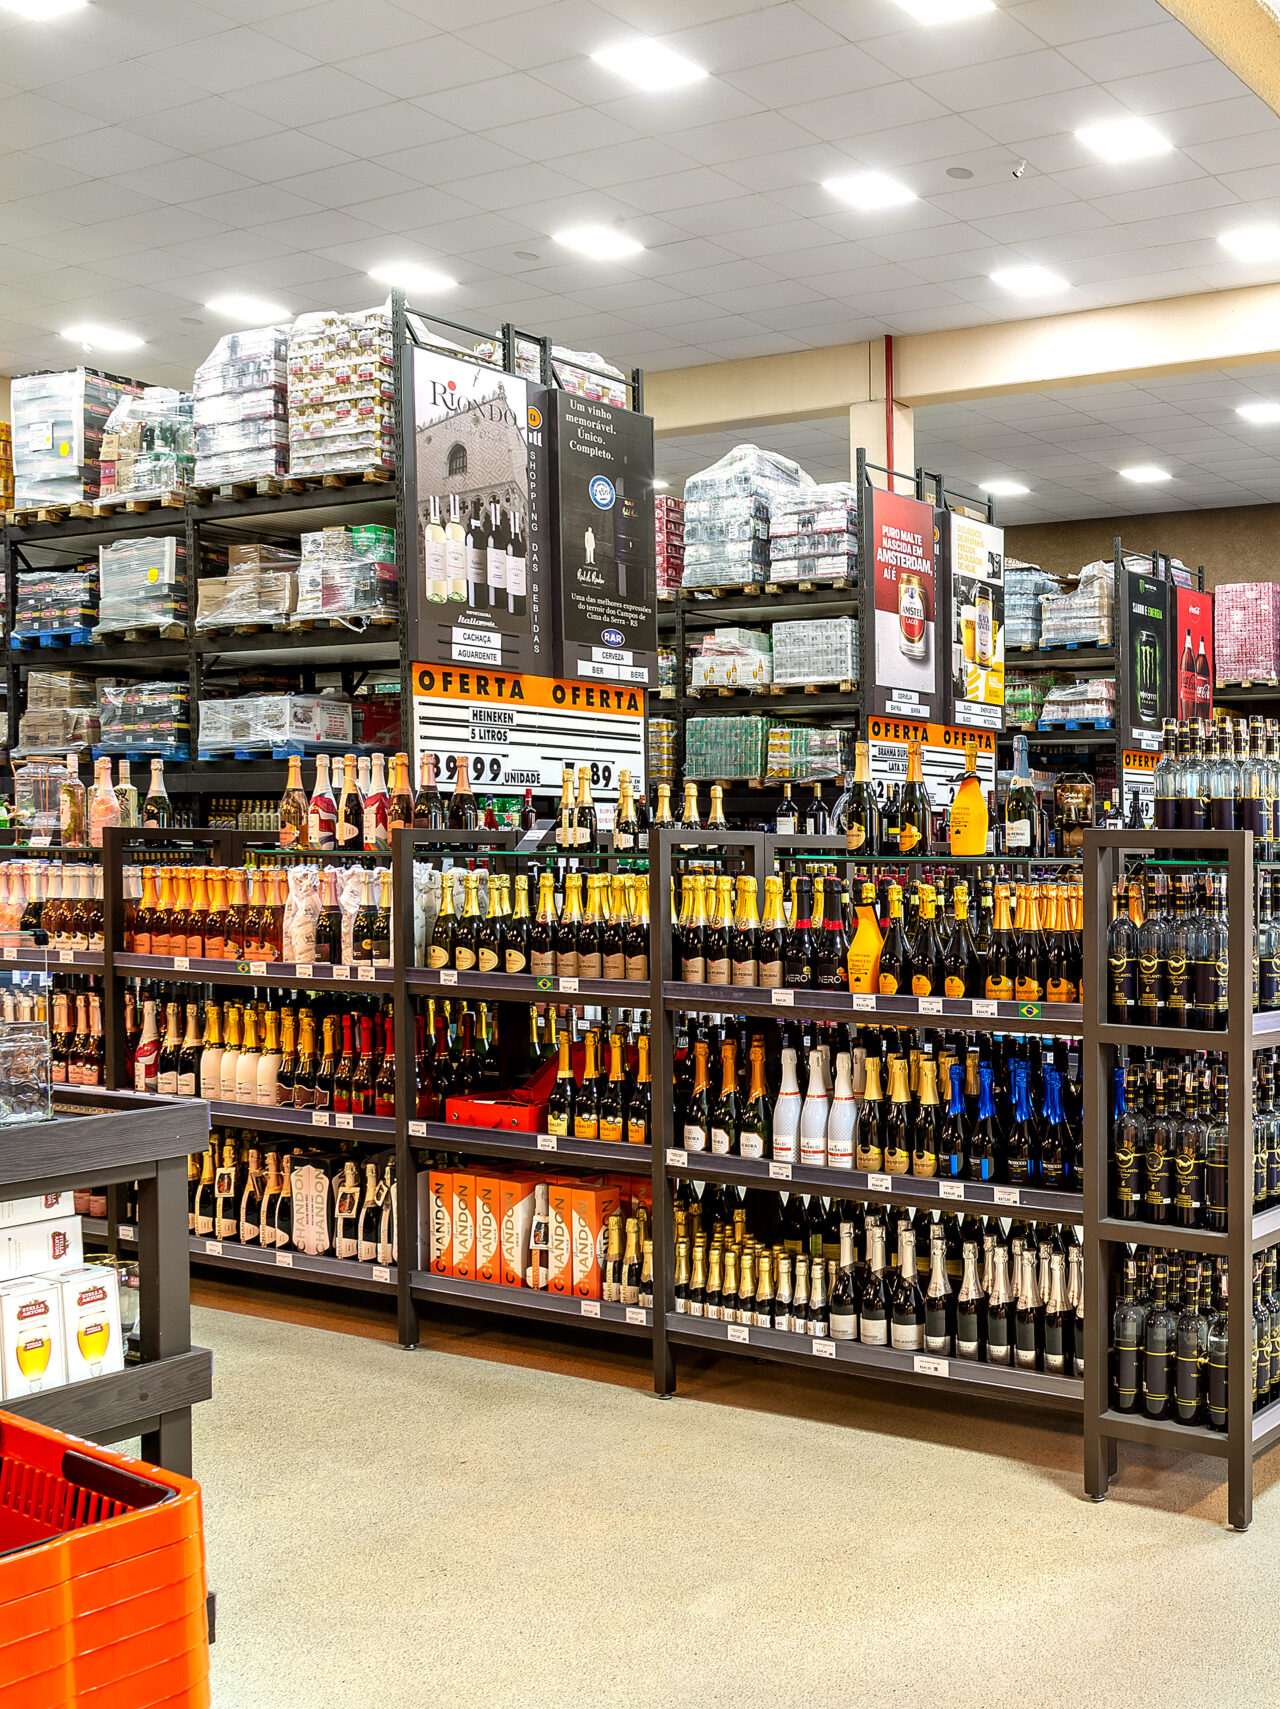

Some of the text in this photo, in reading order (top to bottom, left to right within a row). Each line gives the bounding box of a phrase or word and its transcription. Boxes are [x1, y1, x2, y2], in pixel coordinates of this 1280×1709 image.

[569, 399, 612, 420] Um vinho
[565, 413, 617, 435] memorável.
[577, 426, 606, 445] Único.
[569, 440, 614, 461] Completo.
[529, 451, 538, 531] SHOPPING
[882, 525, 923, 546] PURO MALTE
[882, 538, 923, 557] NASCIDA EM
[876, 547, 933, 577] AMSTERDAM,
[883, 566, 897, 581] AÍ É
[571, 593, 652, 614] Uma das melhores expressões
[577, 602, 646, 620] do terroir dos Campos de
[901, 605, 923, 618] AMSTEL
[532, 584, 540, 654] BEBIDAS
[586, 613, 638, 627] Cima da Serra RS
[905, 617, 919, 626] LAGER
[462, 633, 492, 644] CACHAÇA
[603, 633, 622, 643] RAR
[457, 649, 498, 662] AGUARDENTE
[601, 652, 625, 661] CERVEZA
[418, 669, 639, 712] OFERTA OFERTA
[471, 708, 514, 725] HEINEKEN
[470, 728, 508, 742] 5 LITROS
[871, 721, 993, 750] OFERTA OFERTA
[877, 747, 897, 757] BRAHMA
[472, 757, 502, 781] 99
[590, 762, 612, 788] 89
[888, 762, 901, 771] LATA
[504, 772, 541, 784] UNIDADE
[786, 973, 809, 982] NERO
[817, 975, 842, 984] NERO
[294, 1166, 325, 1256] CHANDON CHANDON
[434, 1182, 446, 1274] CHANDON
[457, 1185, 469, 1276] CHANDON
[481, 1188, 493, 1280] CHANDON
[504, 1192, 515, 1284] CHANDON
[553, 1197, 565, 1292] CHANDON
[577, 1201, 590, 1296] CHANDON
[81, 1289, 103, 1299] STELLA
[21, 1303, 45, 1313] STELLA
